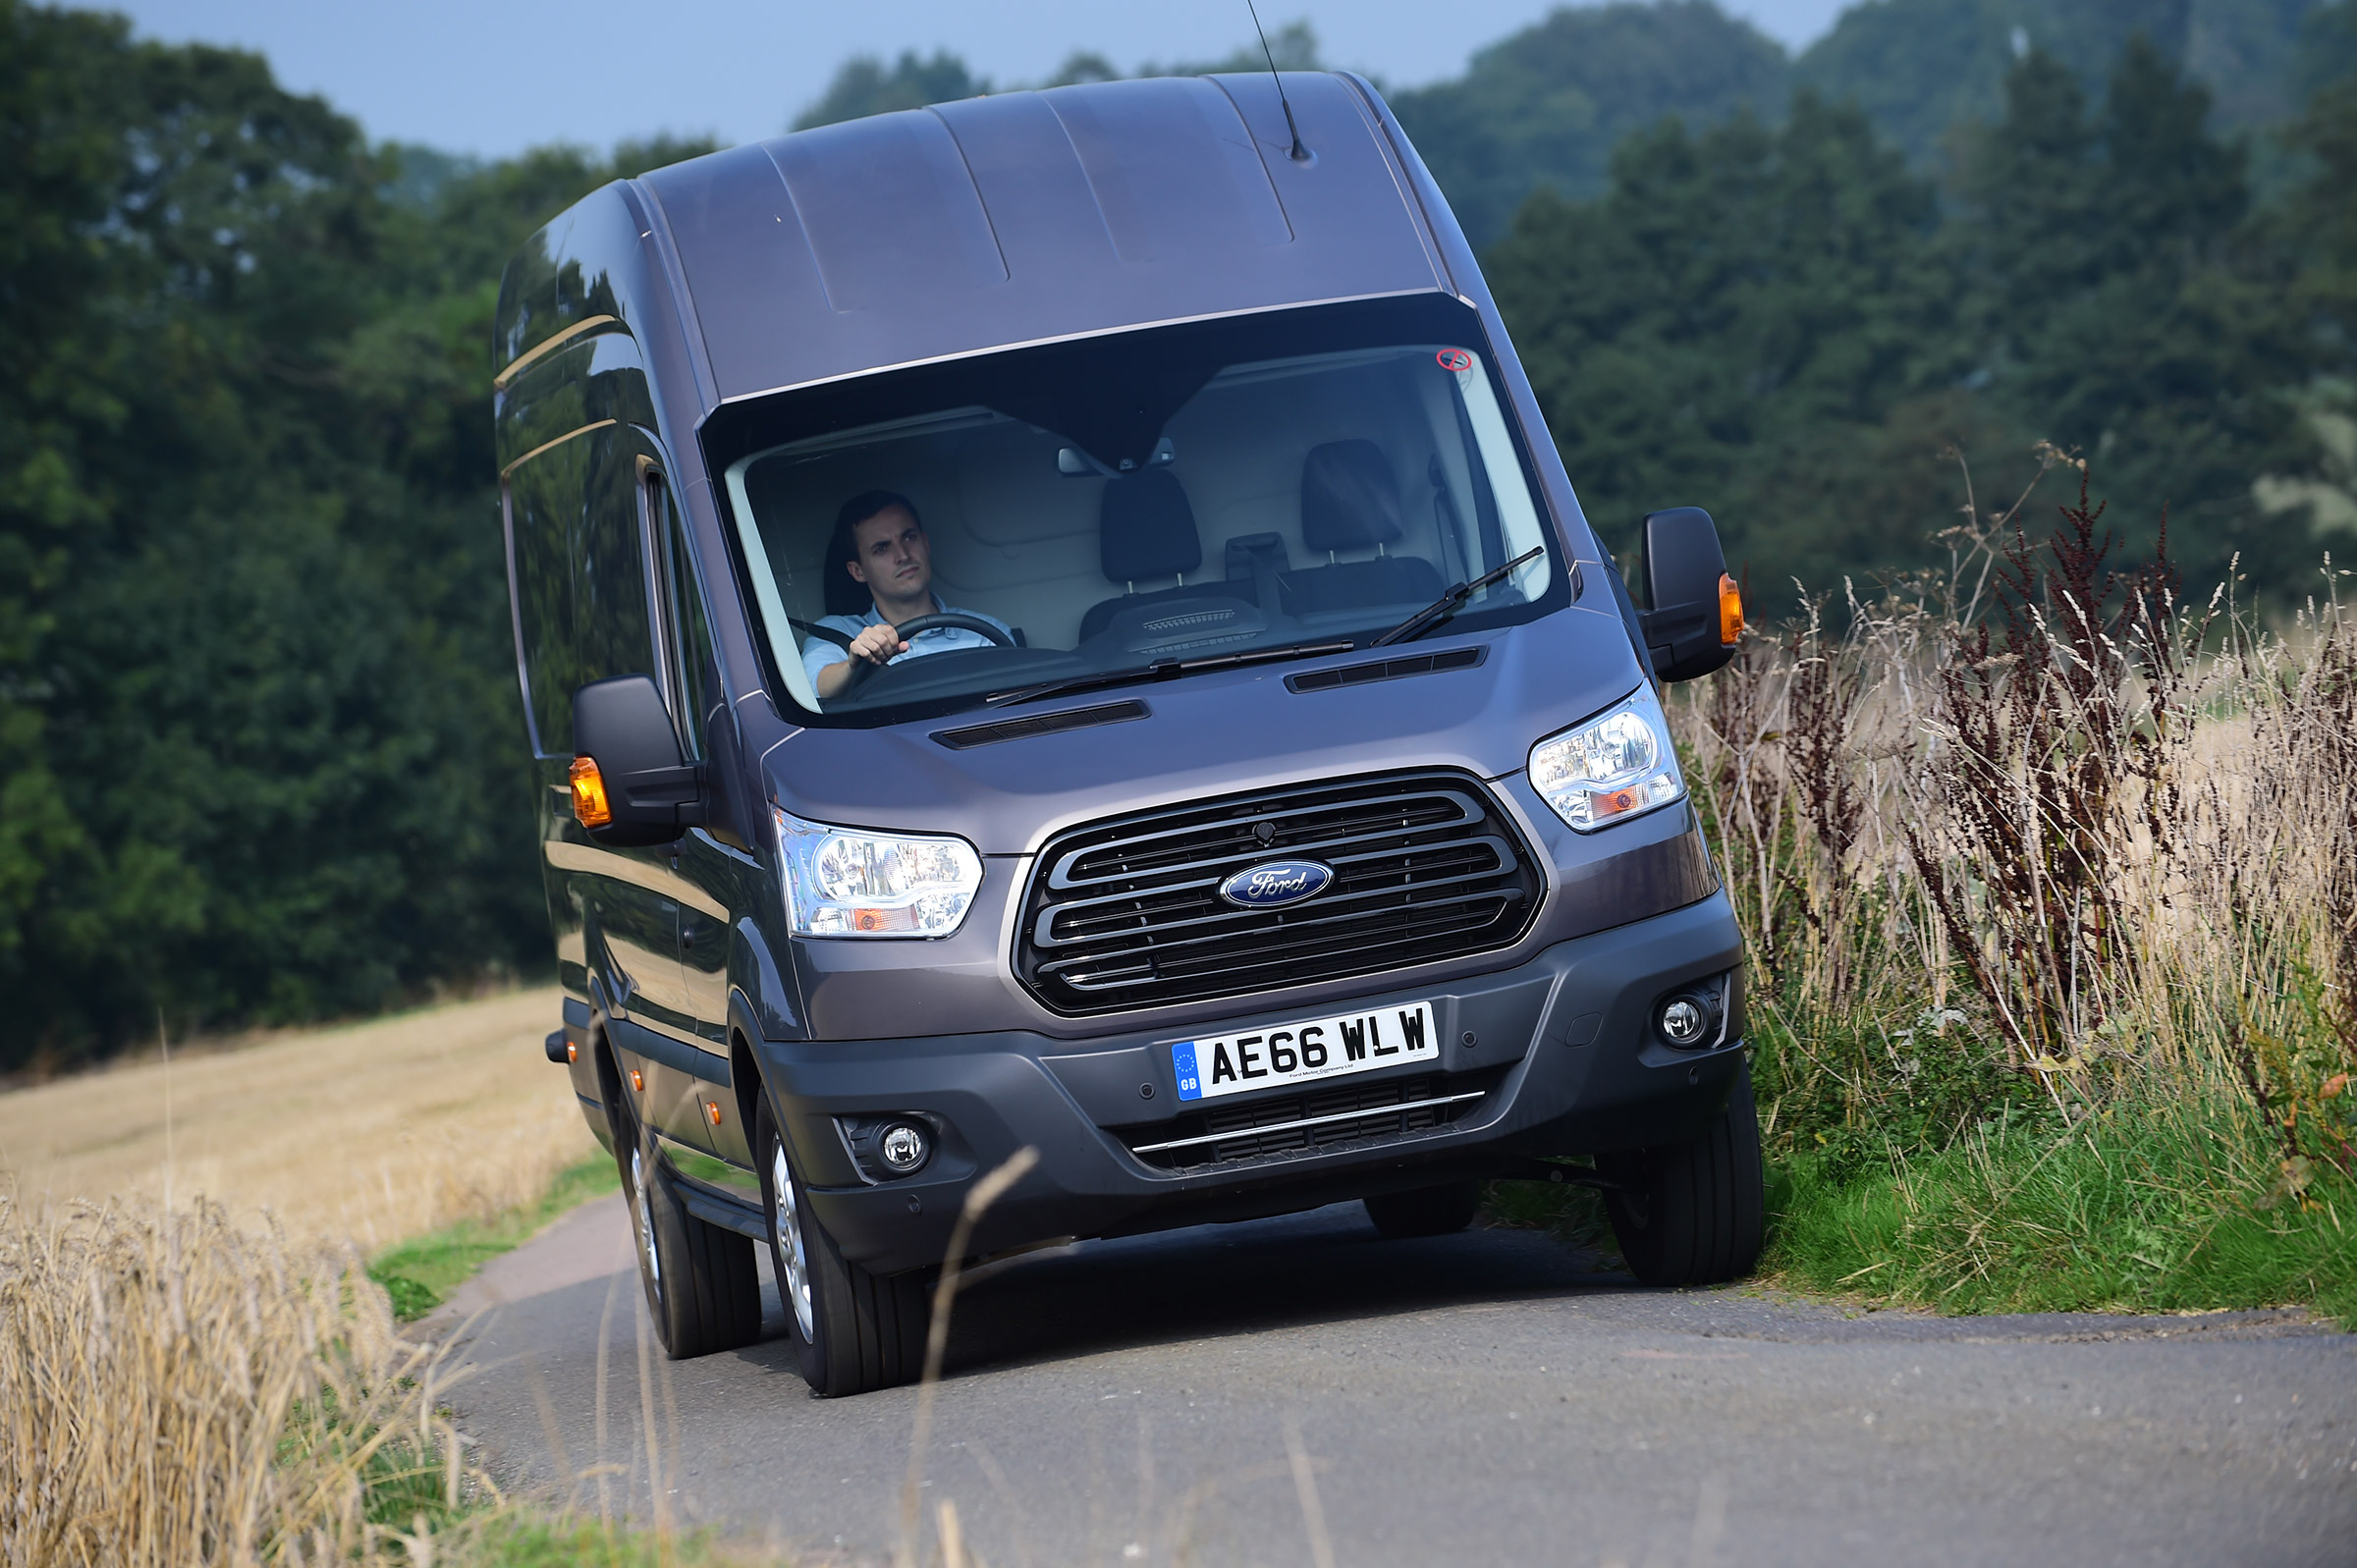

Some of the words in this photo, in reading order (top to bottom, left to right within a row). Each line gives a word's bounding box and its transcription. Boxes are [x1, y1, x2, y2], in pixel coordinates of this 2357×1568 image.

[1247, 868, 1307, 898] Ford
[1212, 1026, 1328, 1085] AE66
[1339, 1007, 1426, 1061] WLW
[1180, 1077, 1197, 1091] GB
